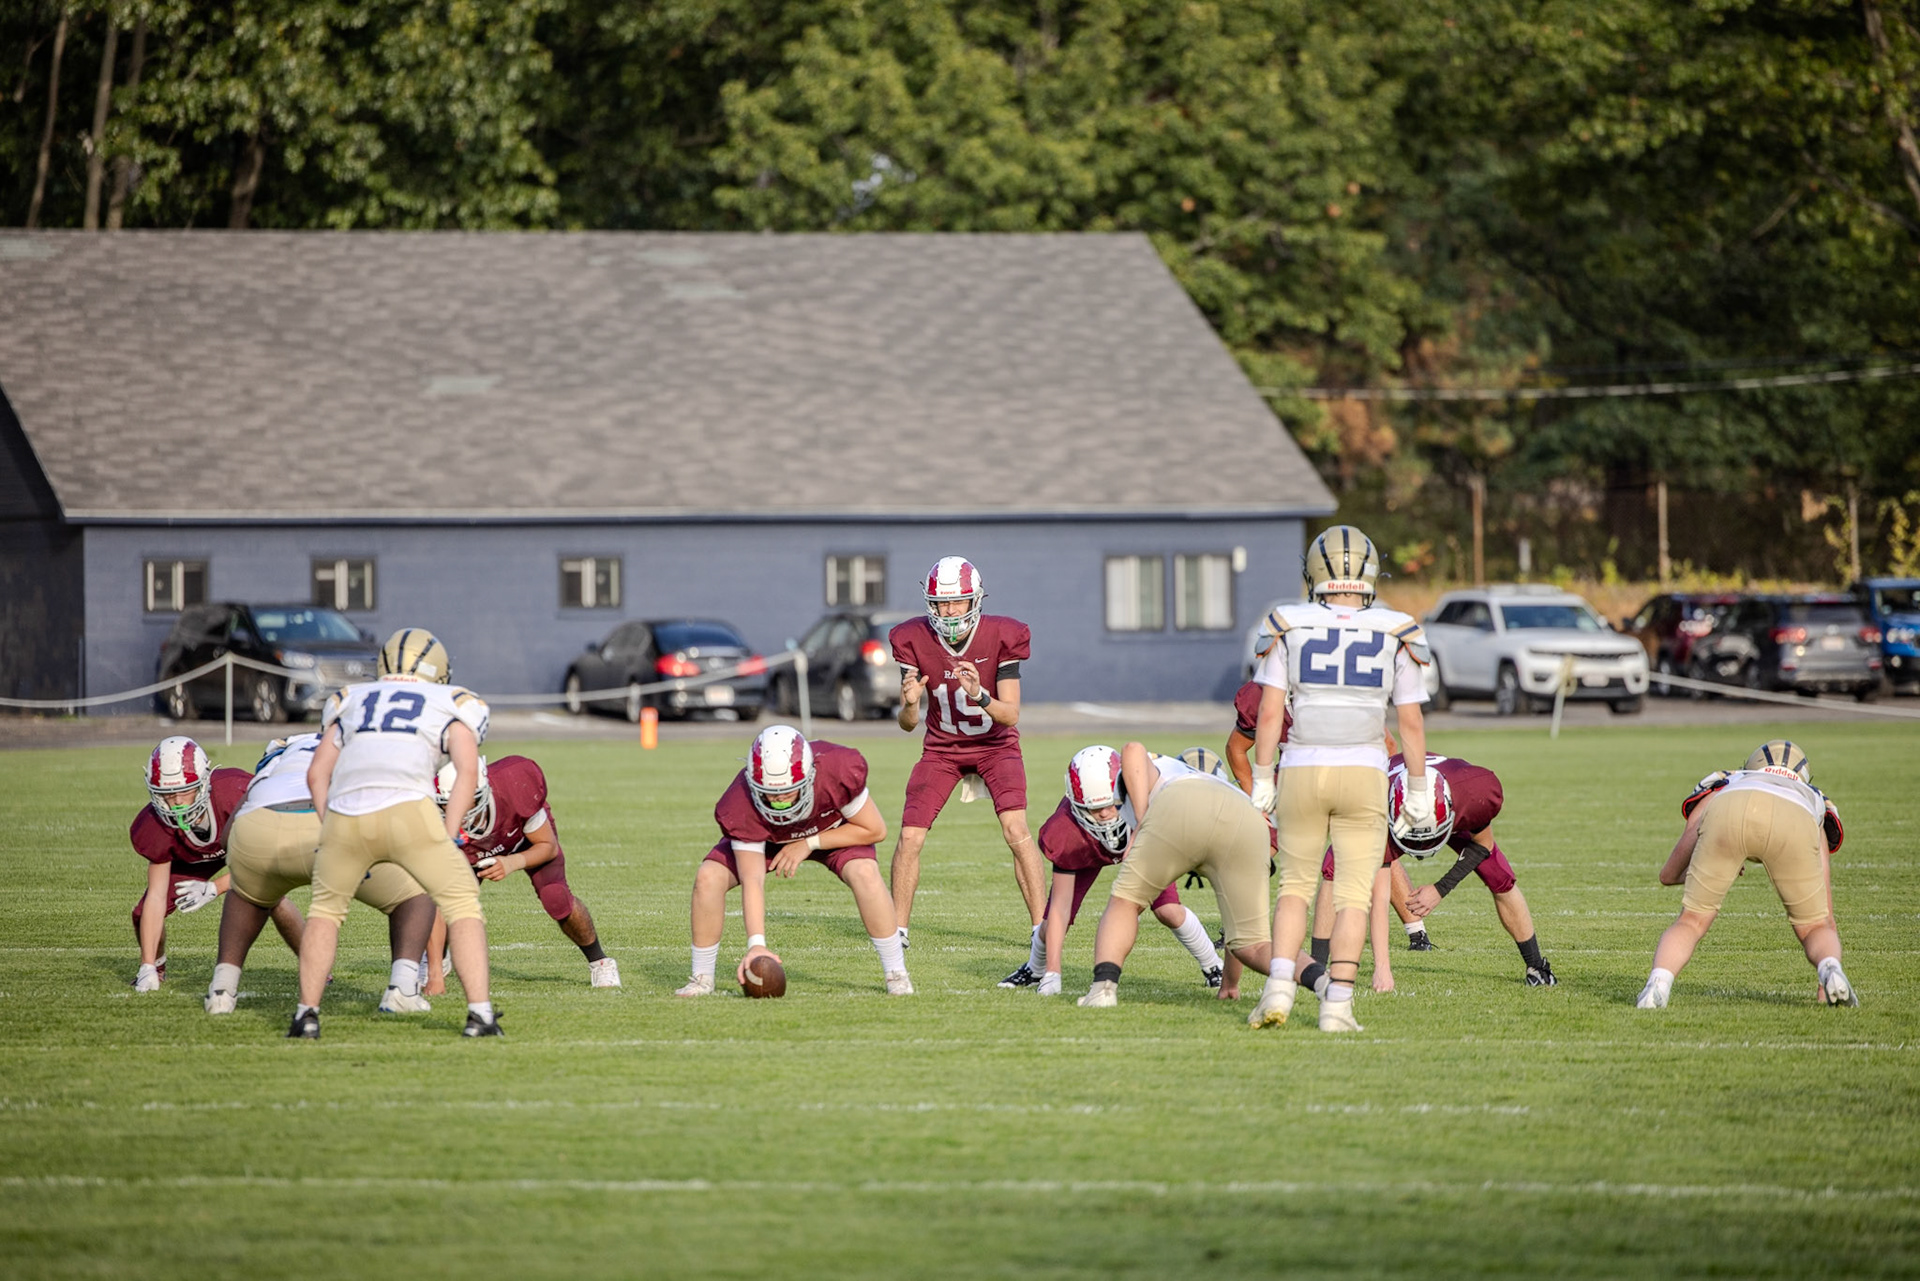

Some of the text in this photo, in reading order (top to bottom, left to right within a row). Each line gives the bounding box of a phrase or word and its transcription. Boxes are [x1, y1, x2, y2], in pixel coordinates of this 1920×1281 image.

[1328, 582, 1364, 591] Riddell
[1299, 628, 1385, 688] 22
[944, 670, 969, 680] RAS
[355, 690, 427, 735] 12
[1764, 767, 1799, 781] Riddell
[790, 825, 819, 839] RAMS
[476, 843, 505, 859] RAMS
